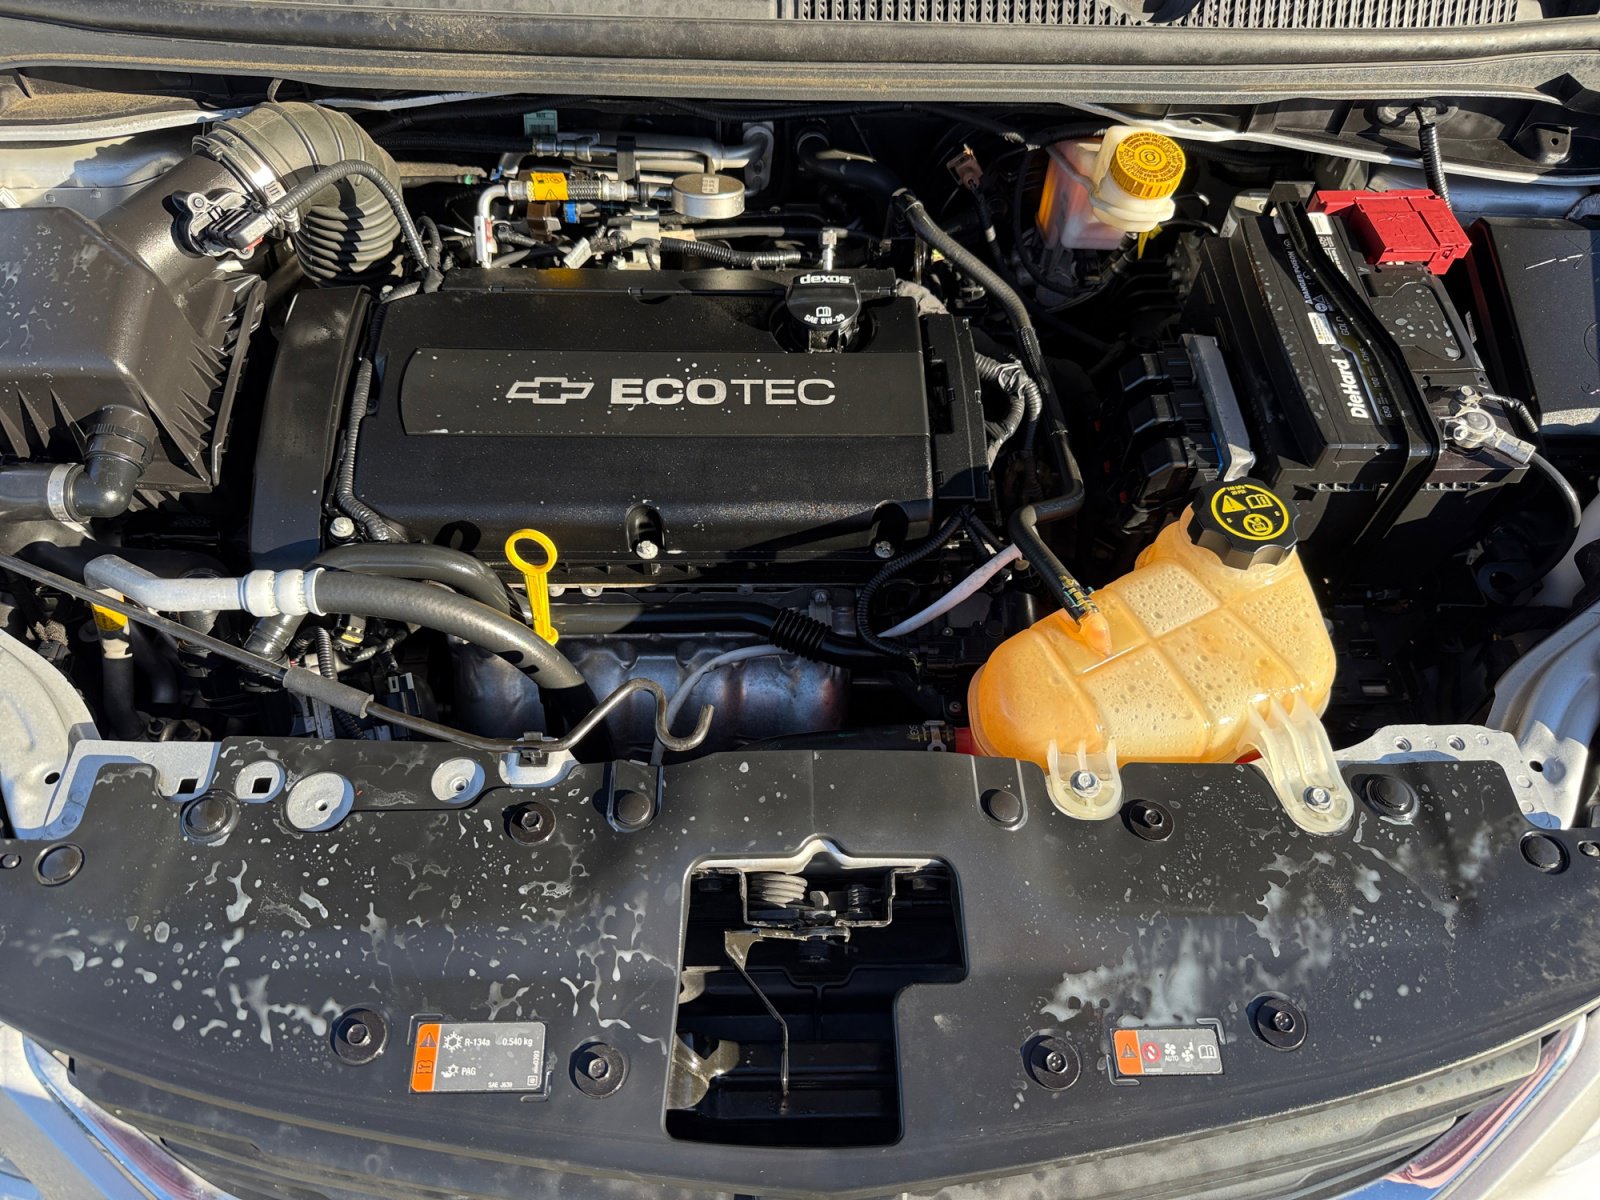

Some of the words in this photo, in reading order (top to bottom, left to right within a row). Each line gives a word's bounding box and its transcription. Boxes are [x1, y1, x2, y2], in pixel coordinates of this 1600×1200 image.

[800, 274, 850, 284] dexos
[804, 314, 819, 324] SAE
[610, 378, 836, 406] ECOTEC
[1331, 358, 1369, 419] DieHard
[464, 1038, 491, 1047] R-134a
[502, 1038, 522, 1046] 0.540
[523, 1037, 533, 1048] kg
[461, 1067, 477, 1076] PAG
